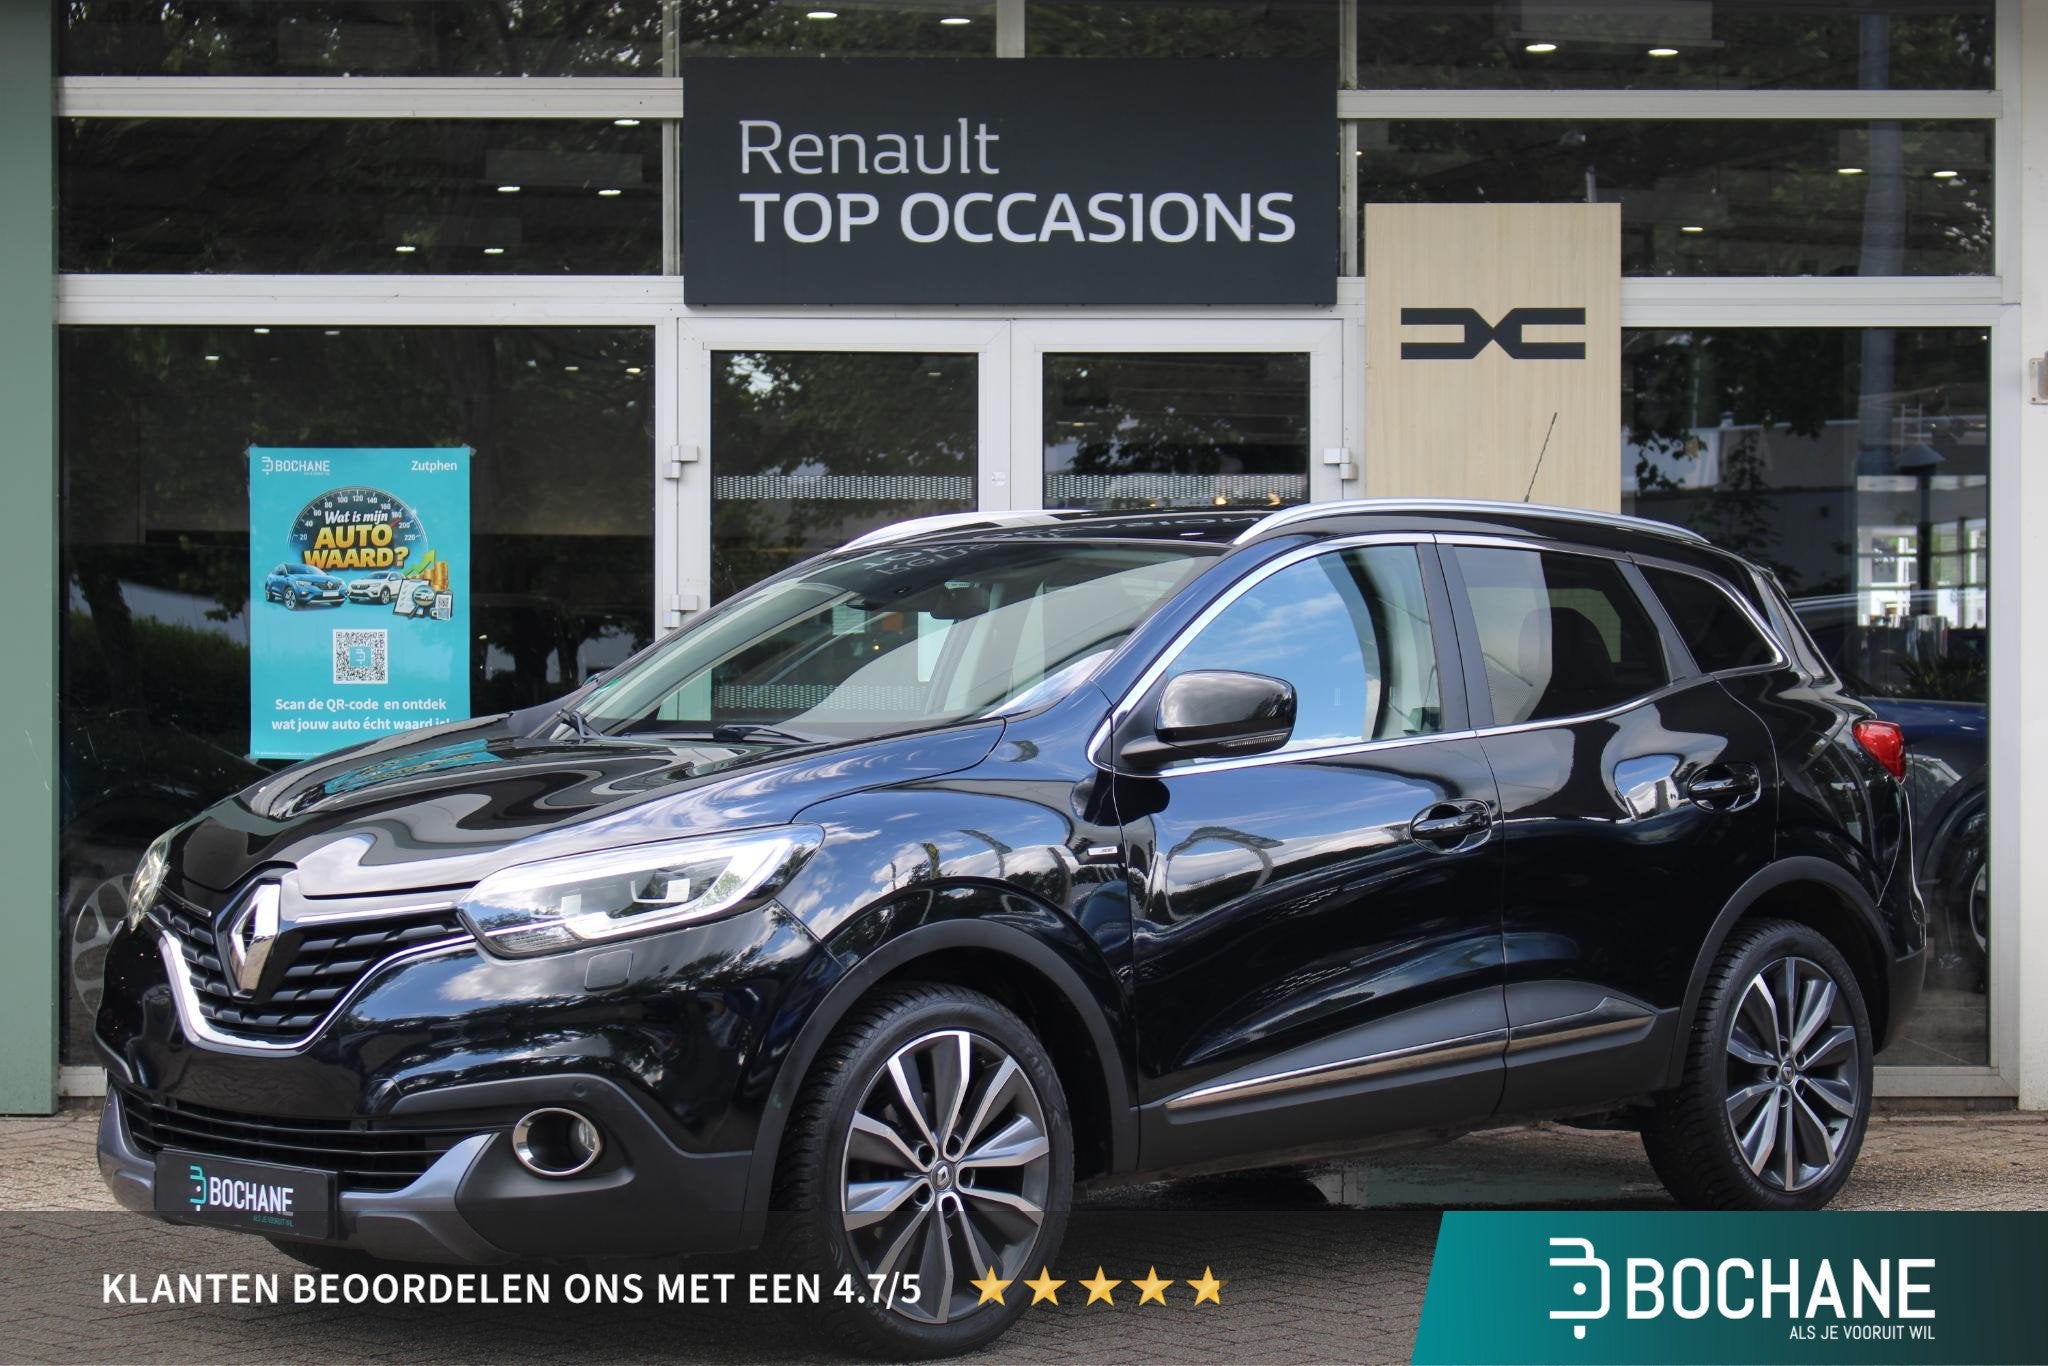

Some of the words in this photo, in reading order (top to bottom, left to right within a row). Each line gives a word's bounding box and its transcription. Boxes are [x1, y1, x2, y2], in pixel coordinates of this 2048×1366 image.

[739, 117, 1000, 175] Renault
[739, 192, 880, 243] TOP
[900, 192, 1296, 243] OCCASIONS
[275, 459, 331, 472] BOCHANE
[411, 460, 458, 473] Zutphen
[324, 510, 350, 525] Wat
[352, 509, 362, 520] is
[362, 509, 389, 525] mijn
[313, 523, 393, 550] AUTO
[303, 546, 410, 569] WAARD?
[275, 698, 305, 710] Scan
[308, 698, 324, 710] de
[326, 698, 379, 713] QR-code
[383, 701, 400, 710] en
[402, 698, 447, 710] ontdek
[271, 719, 296, 730] wat
[297, 718, 329, 733] jouw
[331, 719, 361, 730] auto
[363, 716, 391, 730] écht
[209, 1176, 294, 1216] BOCHANE
